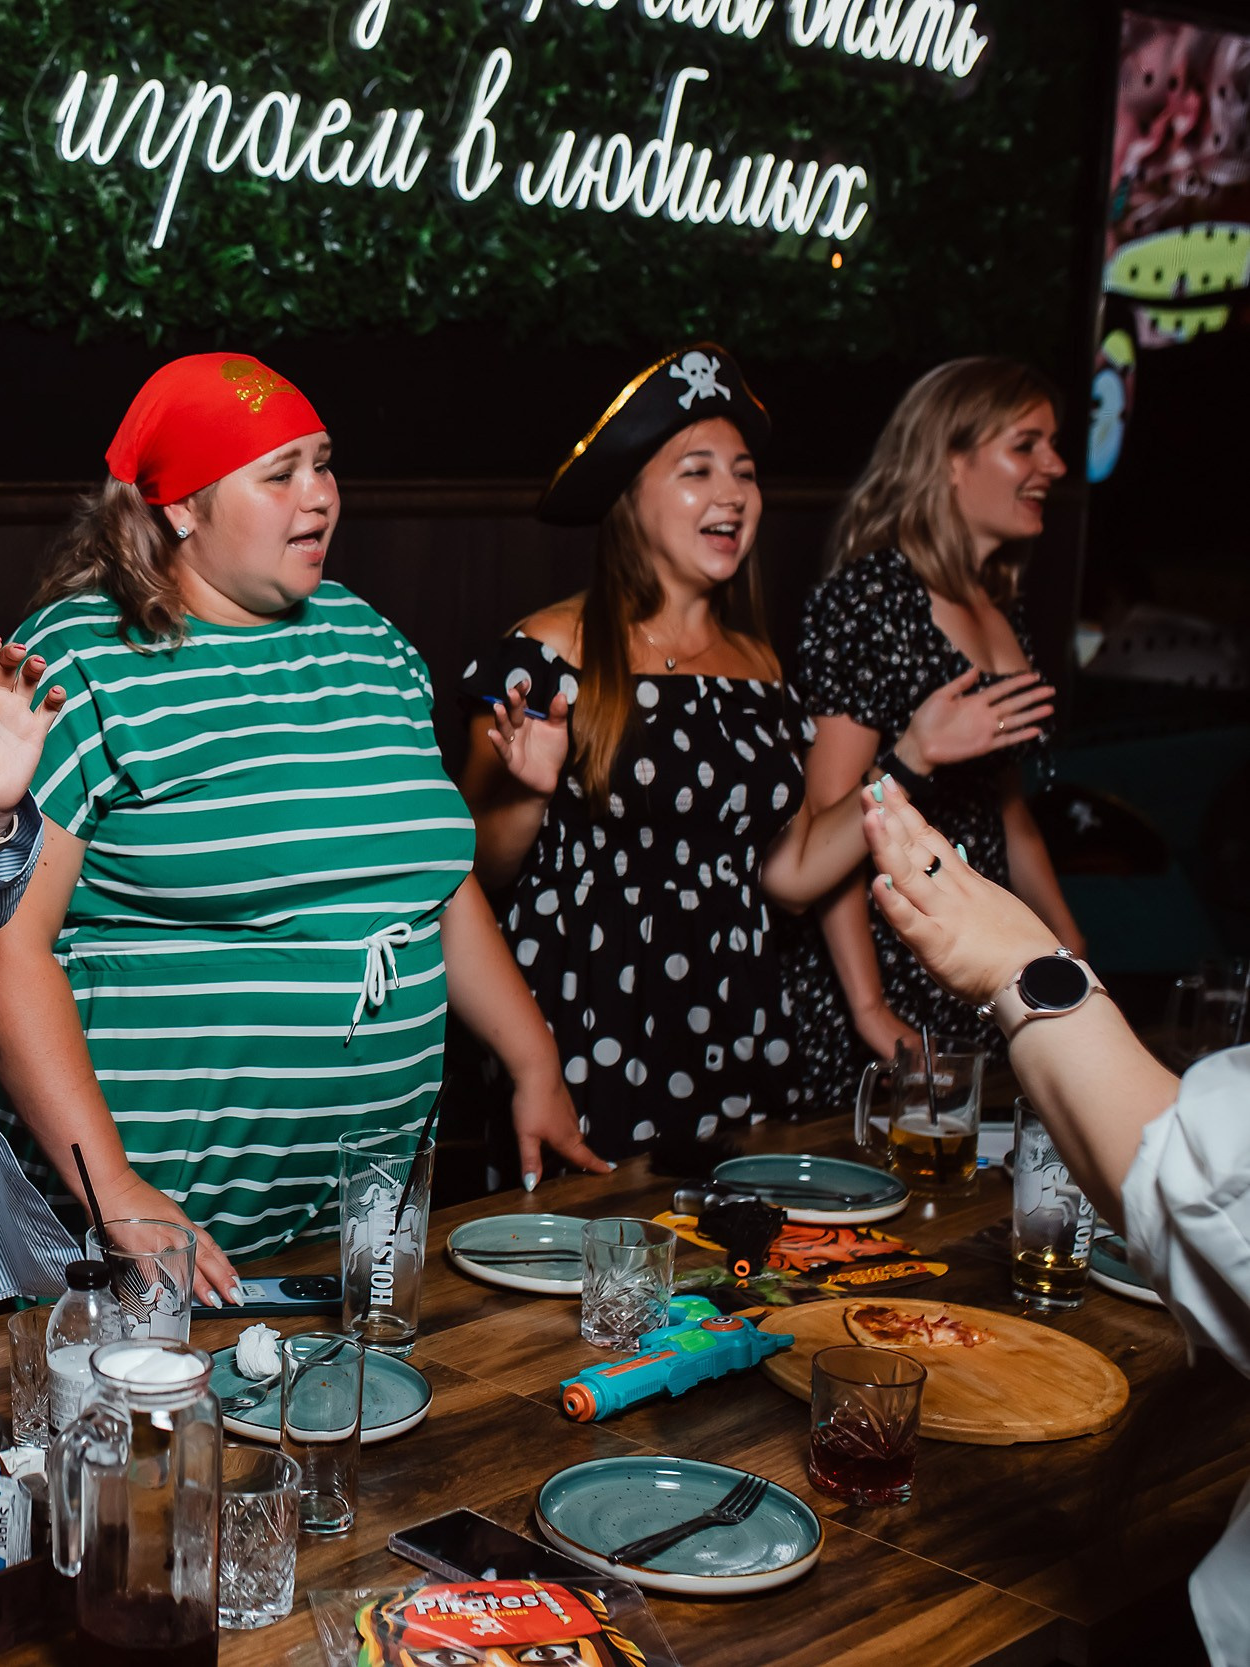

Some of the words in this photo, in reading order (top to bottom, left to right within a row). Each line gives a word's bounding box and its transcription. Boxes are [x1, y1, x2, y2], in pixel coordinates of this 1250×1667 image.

[55, 69, 430, 250] играем
[452, 46, 512, 201] в
[519, 66, 869, 240] любимых
[1072, 1193, 1095, 1259] HOLS
[414, 1594, 540, 1614] Pirates
